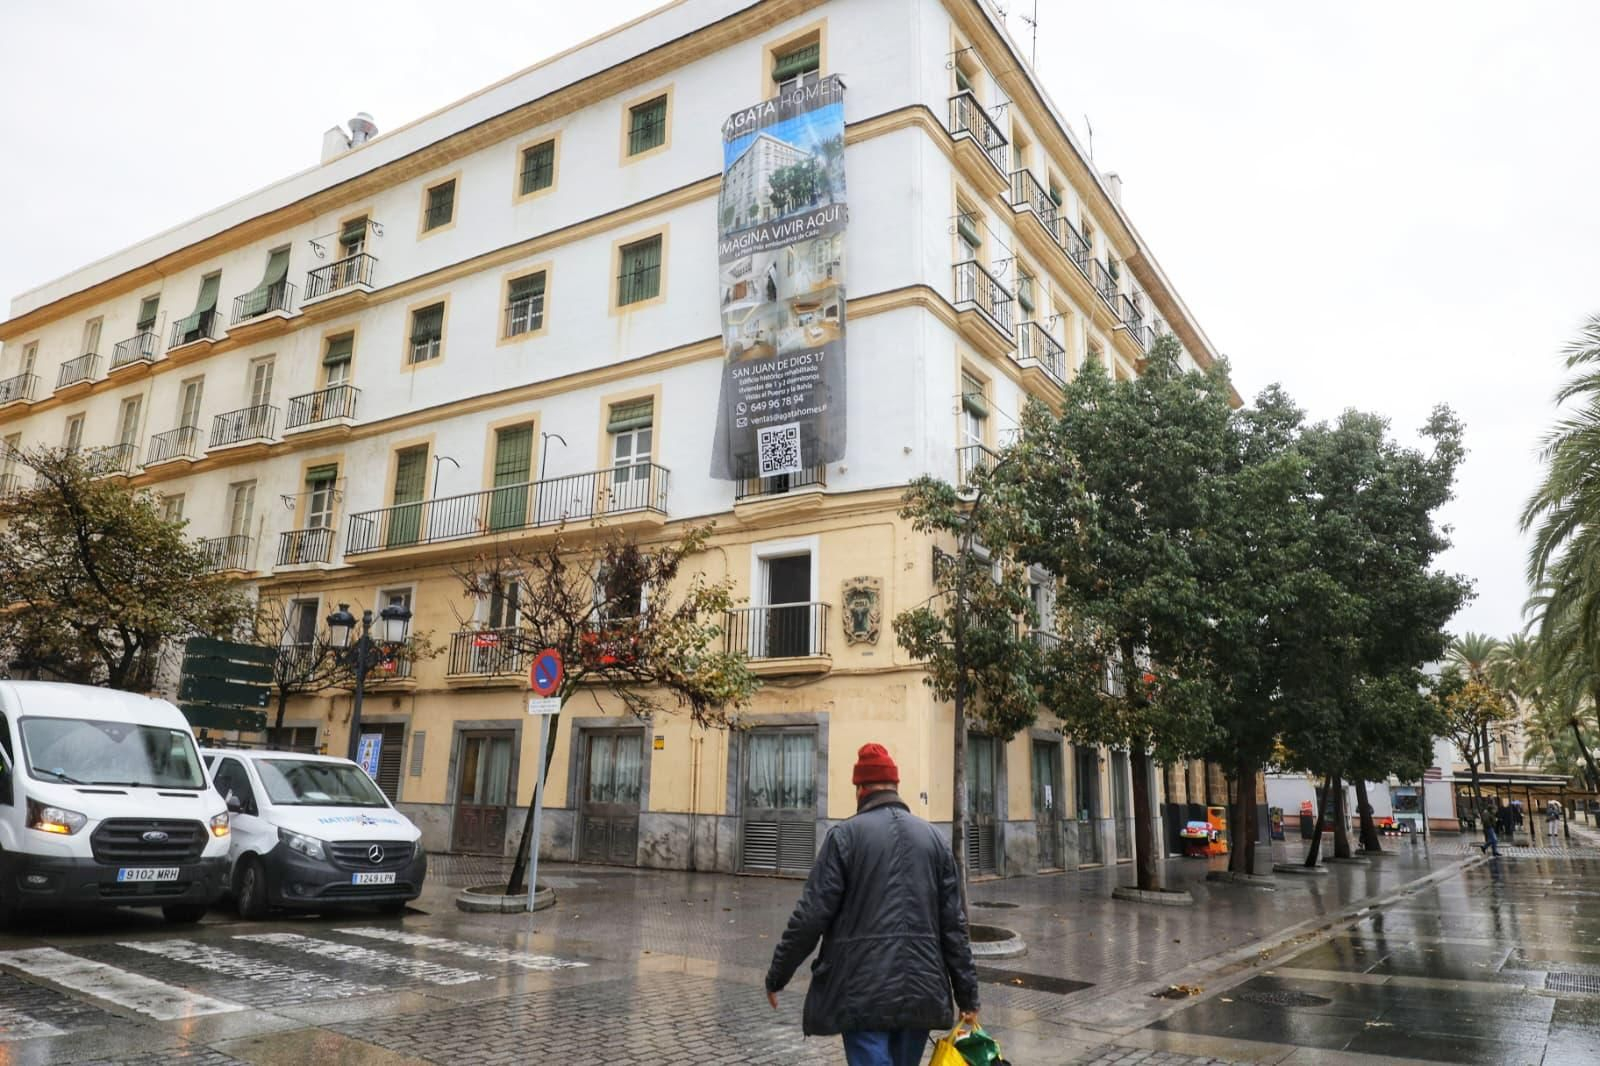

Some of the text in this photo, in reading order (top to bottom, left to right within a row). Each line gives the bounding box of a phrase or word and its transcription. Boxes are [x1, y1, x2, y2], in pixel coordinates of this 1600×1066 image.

[780, 77, 842, 109] HOMES
[719, 229, 770, 257] IMAGINA
[772, 219, 804, 239] VIVIR
[732, 351, 825, 379] SAN JUAN DE DIOS 17
[784, 366, 818, 376] rehabilitado
[786, 373, 820, 384] dormitorios
[750, 394, 804, 412] 649 96 78 94
[126, 869, 178, 880] 9102 MRH
[360, 874, 394, 883] 1249 LPK
